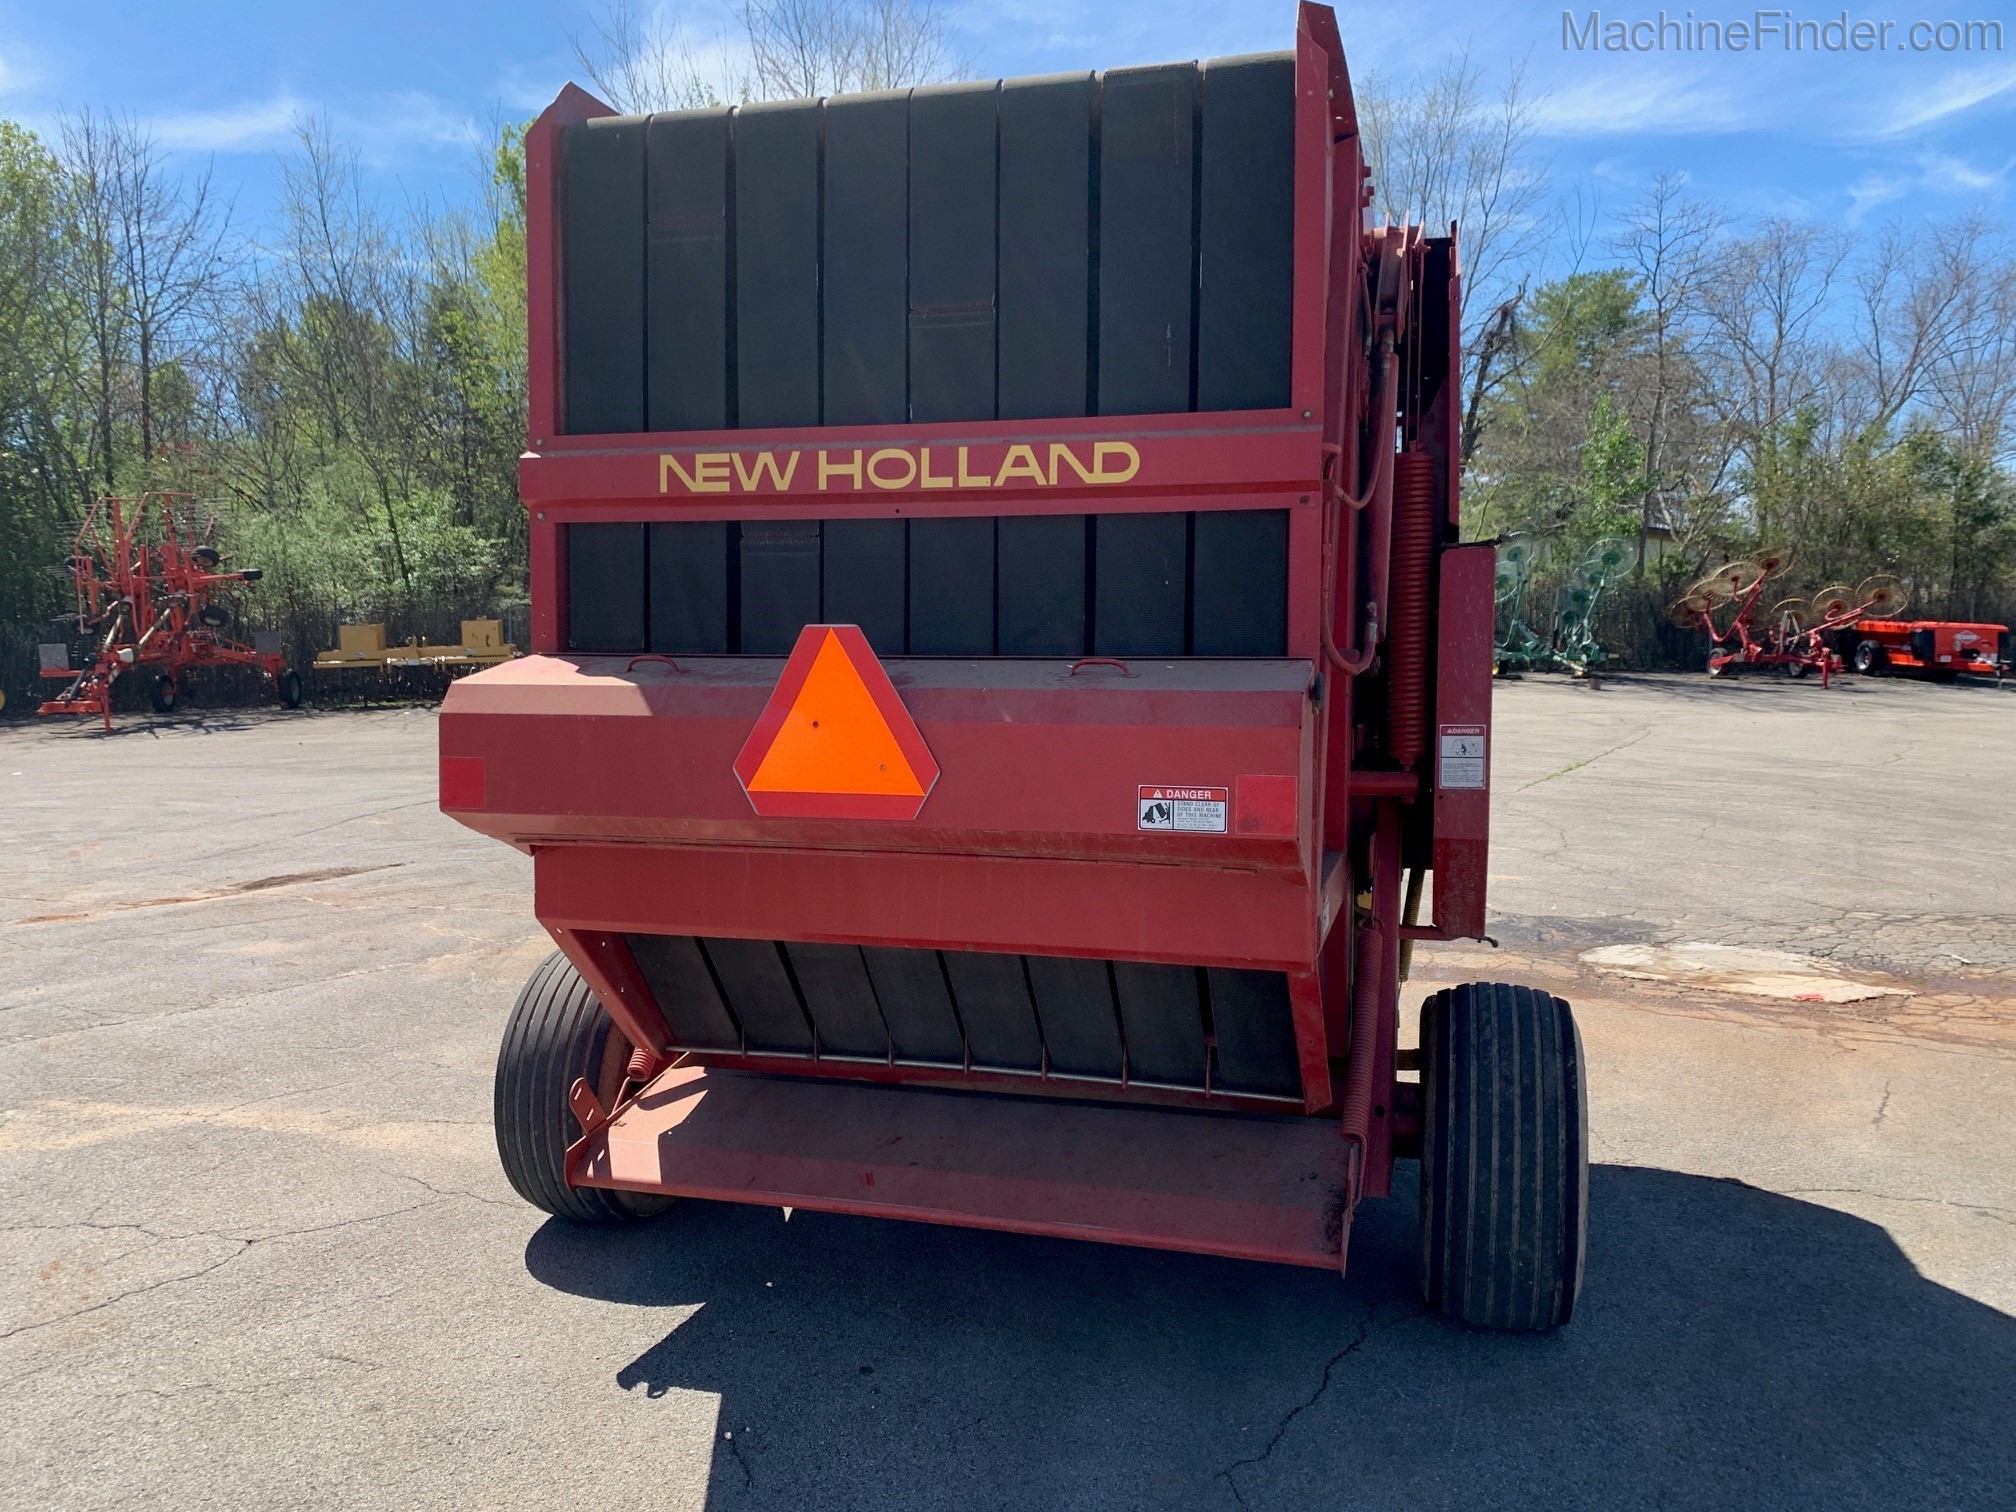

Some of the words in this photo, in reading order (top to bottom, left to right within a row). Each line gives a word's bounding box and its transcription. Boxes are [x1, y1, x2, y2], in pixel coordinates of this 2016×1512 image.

[660, 450, 800, 493] NEW
[818, 441, 1141, 490] HOLLAND
[1166, 789, 1212, 800] DANGER
